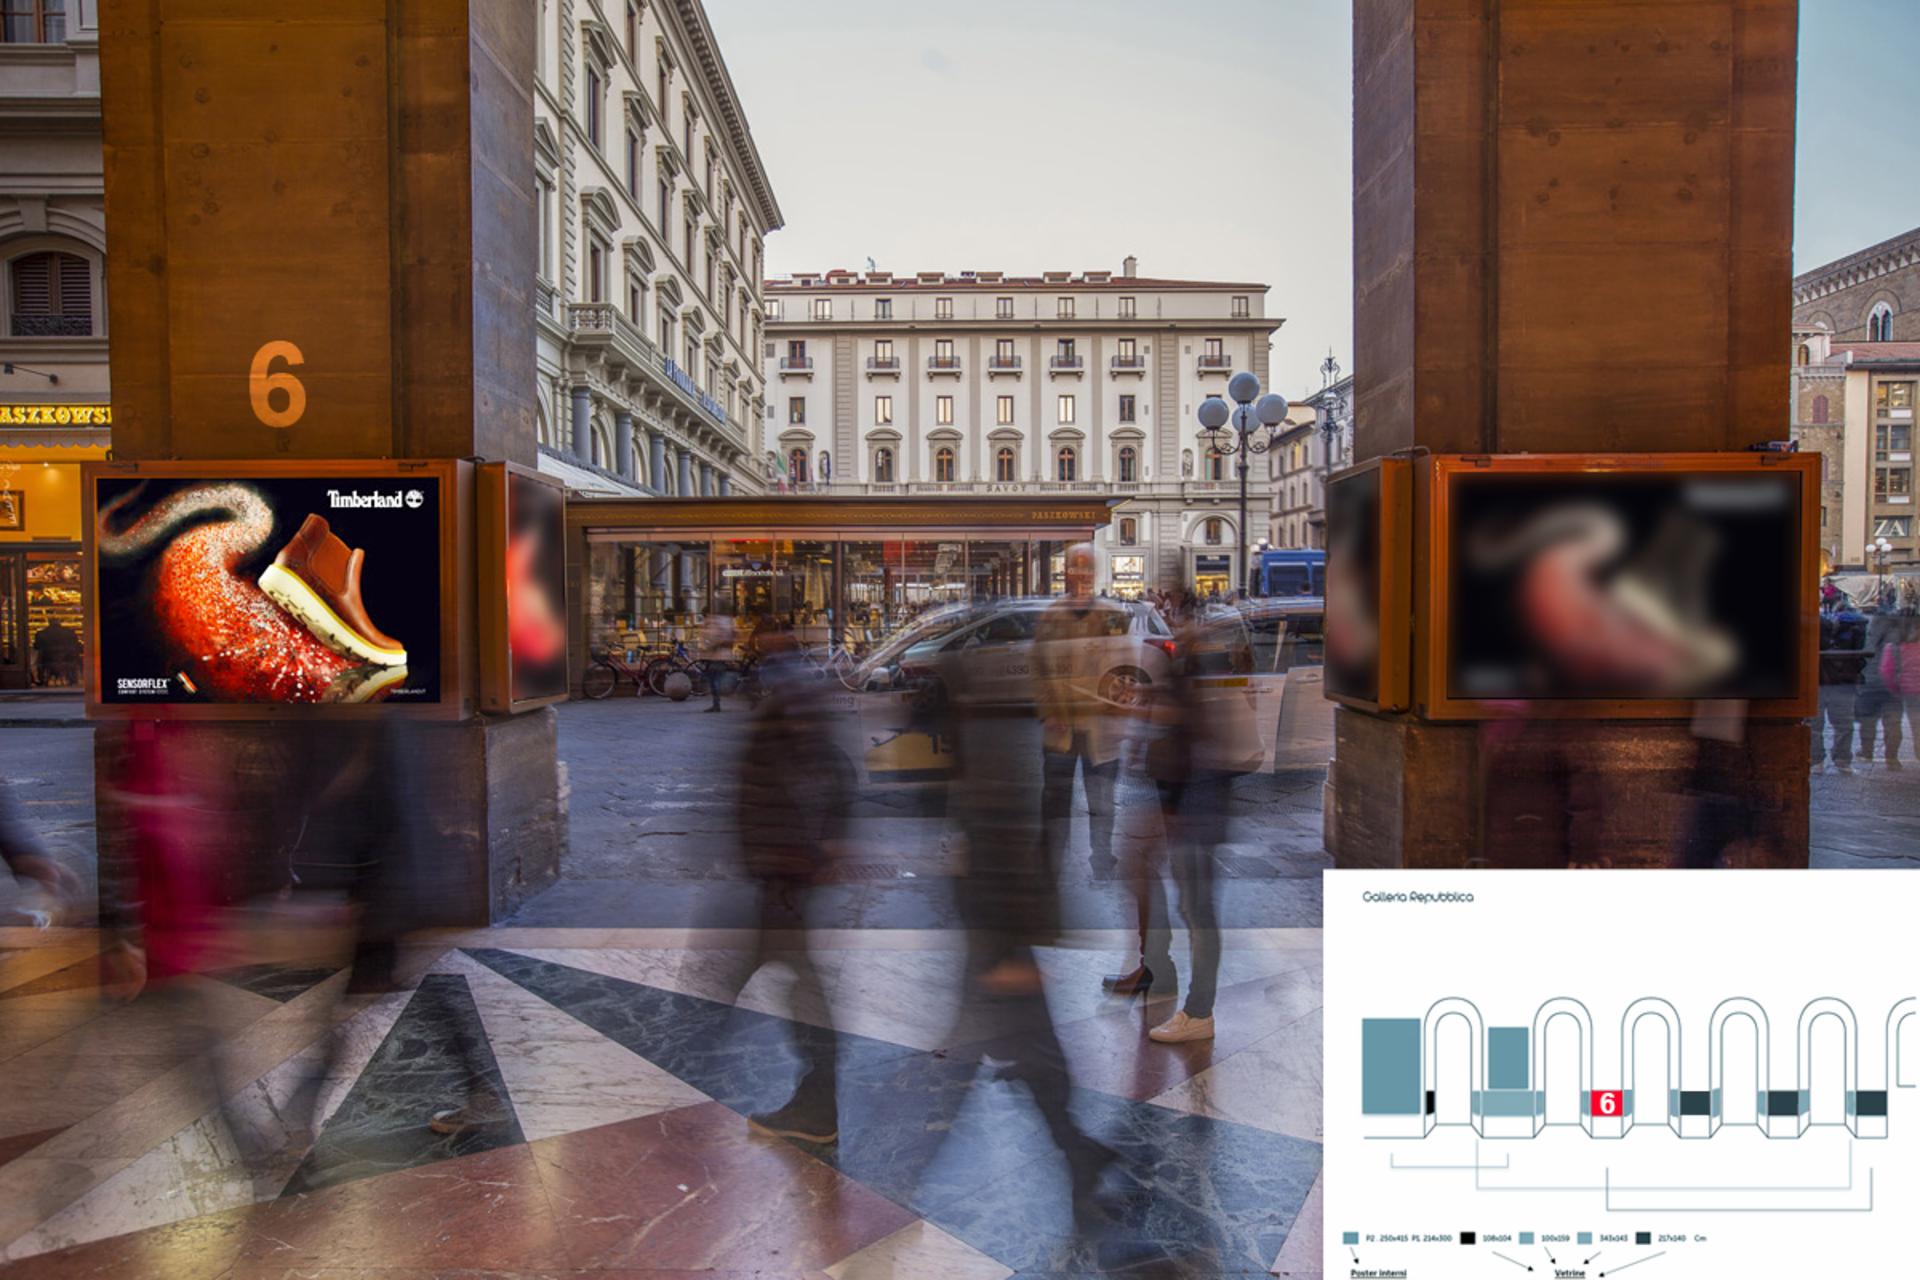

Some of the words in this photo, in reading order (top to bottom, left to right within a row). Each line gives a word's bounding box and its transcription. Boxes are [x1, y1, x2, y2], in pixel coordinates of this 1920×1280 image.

[249, 340, 306, 428] 6
[986, 484, 1026, 493] SAVOY
[327, 489, 403, 508] Timberland
[1031, 511, 1096, 520] PASZKOWSKI
[117, 678, 168, 689] SENSORFLEX
